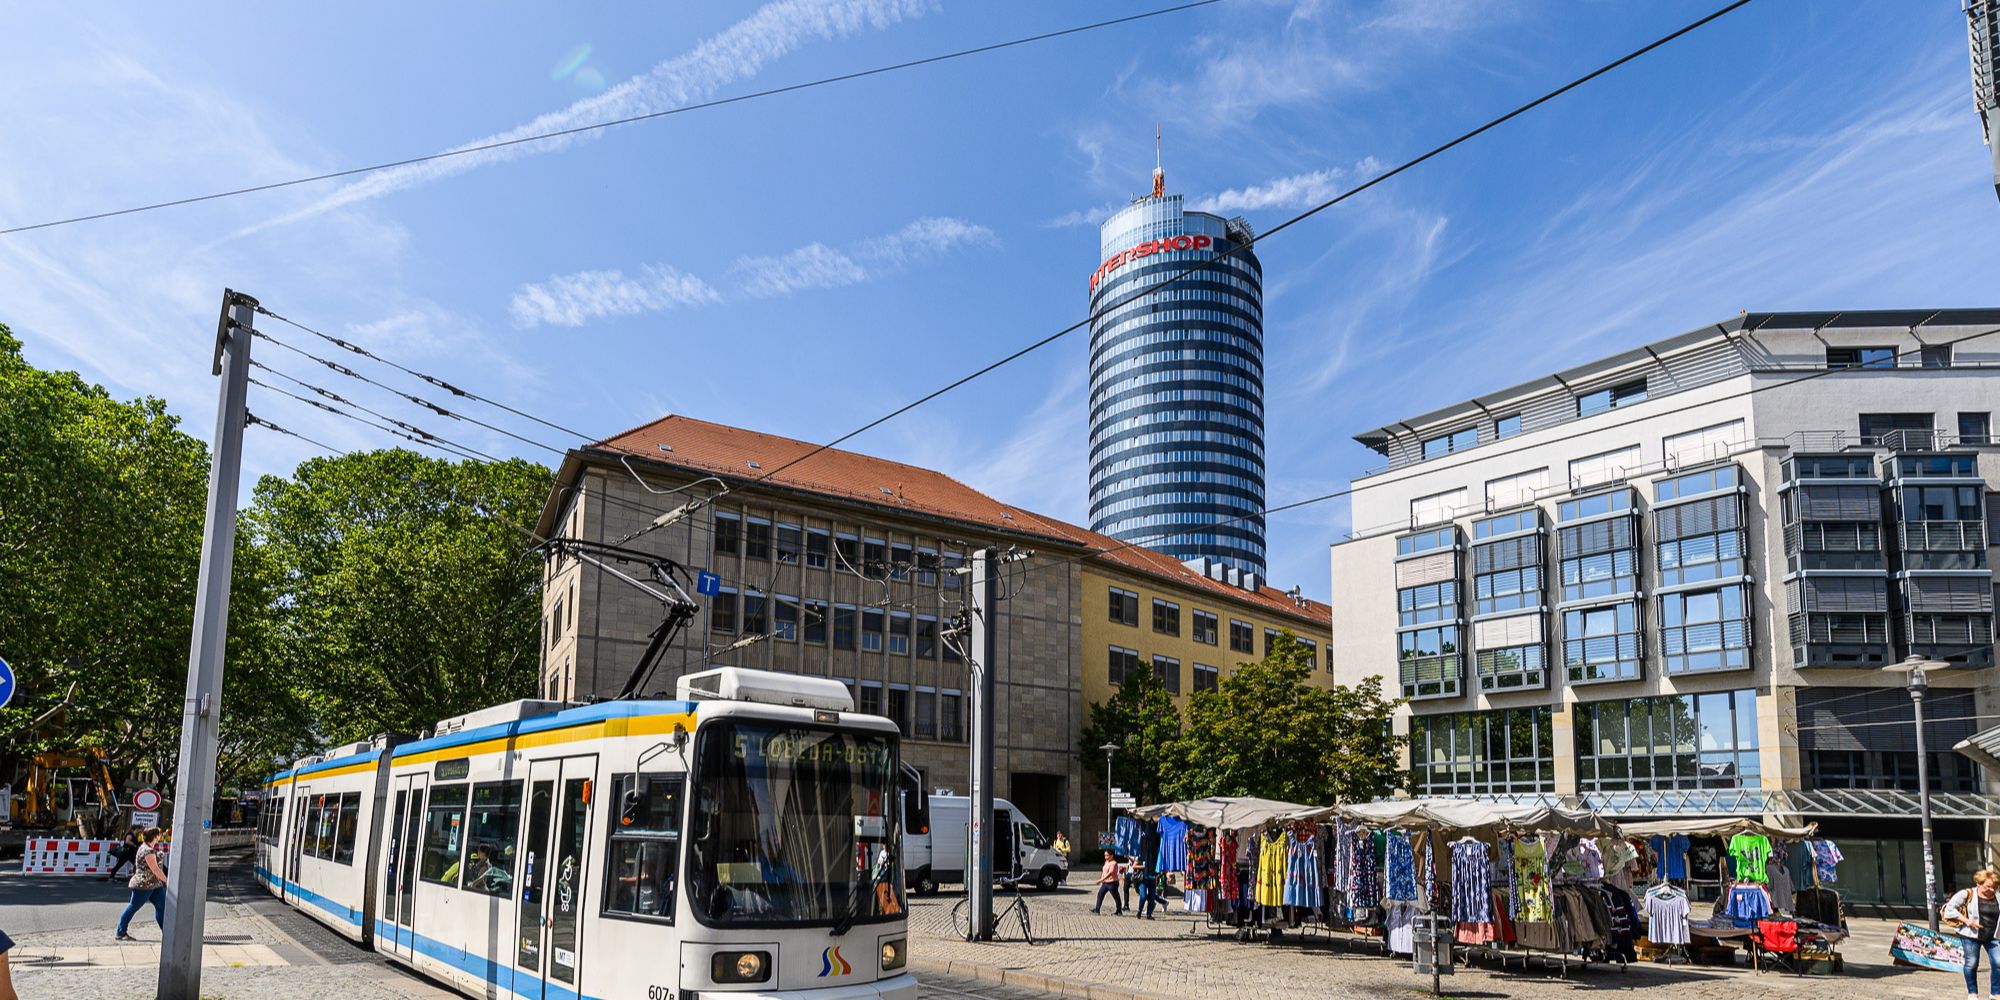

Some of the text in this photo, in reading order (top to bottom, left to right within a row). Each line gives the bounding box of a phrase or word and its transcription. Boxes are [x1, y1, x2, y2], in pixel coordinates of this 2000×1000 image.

[703, 574, 716, 592] T
[735, 734, 878, 765] 5 LOBEDA-OST
